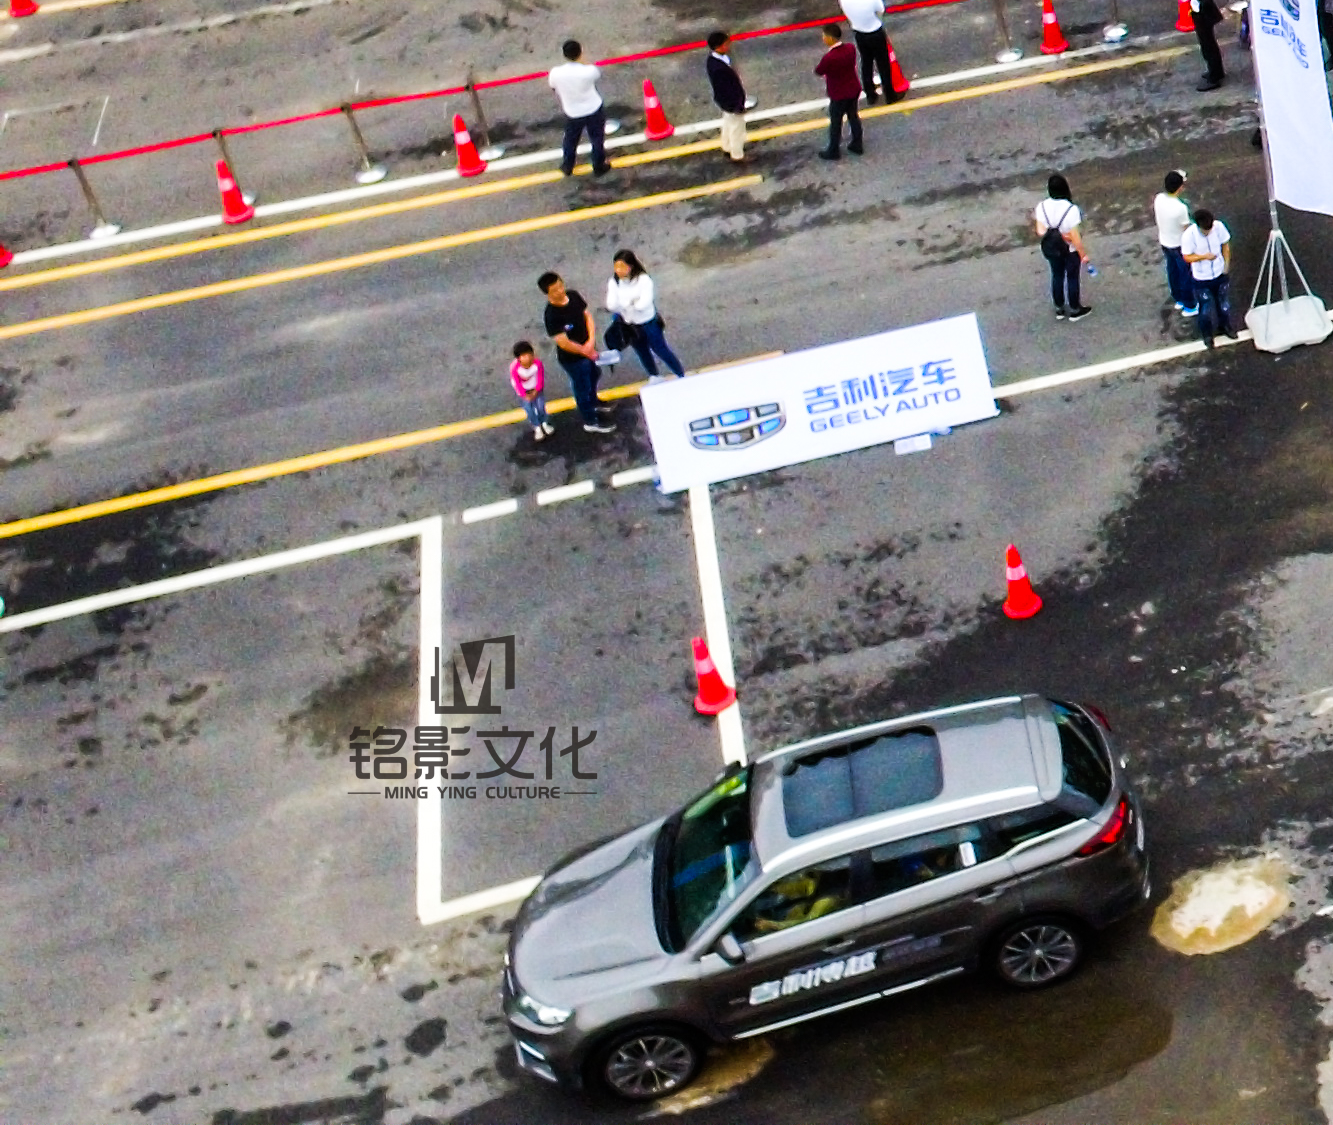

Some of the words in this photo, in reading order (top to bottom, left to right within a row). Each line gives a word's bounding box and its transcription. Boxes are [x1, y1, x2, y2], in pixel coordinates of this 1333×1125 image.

[803, 358, 956, 414] 吉利汽车
[810, 404, 889, 433] GEELY
[896, 388, 961, 413] AUTO
